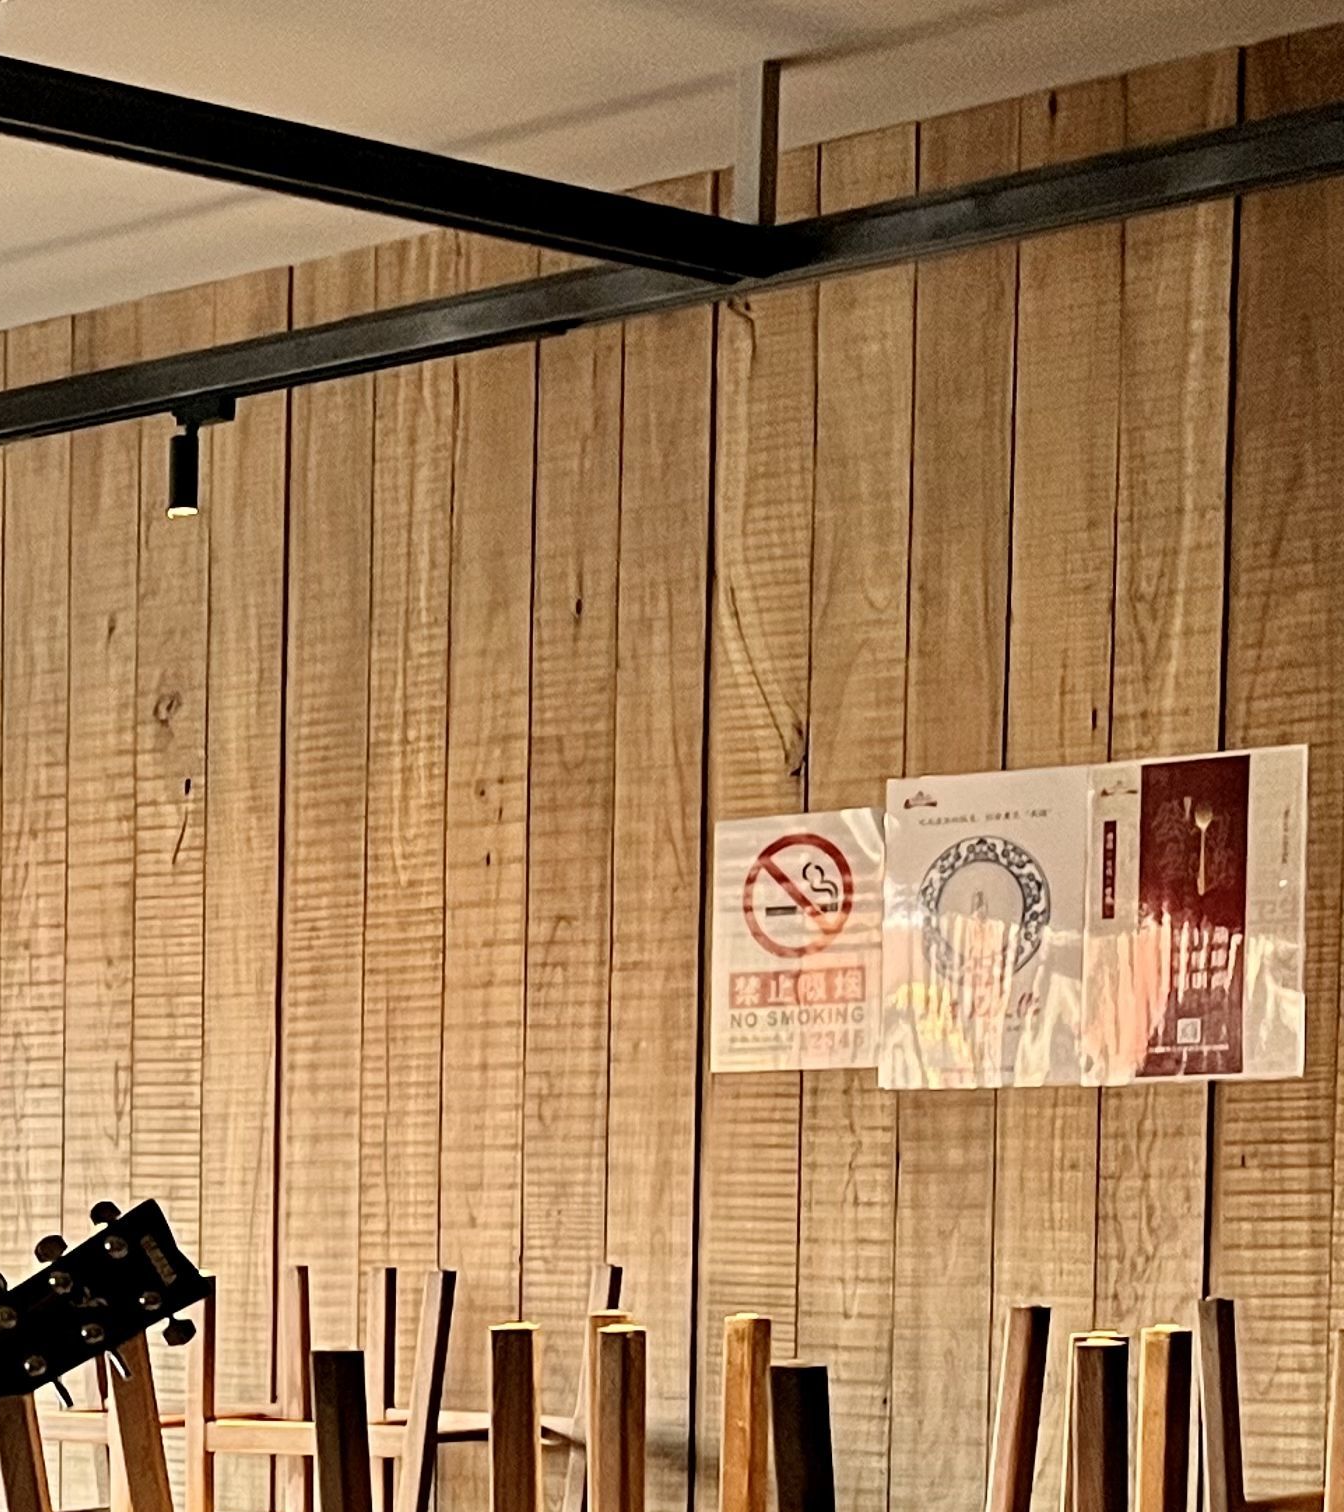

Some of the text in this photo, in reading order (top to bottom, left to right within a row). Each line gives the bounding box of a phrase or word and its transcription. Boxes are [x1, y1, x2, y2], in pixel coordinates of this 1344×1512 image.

[734, 971, 862, 1006] 禁止吸烟
[730, 1006, 864, 1028] NO SMOKING
